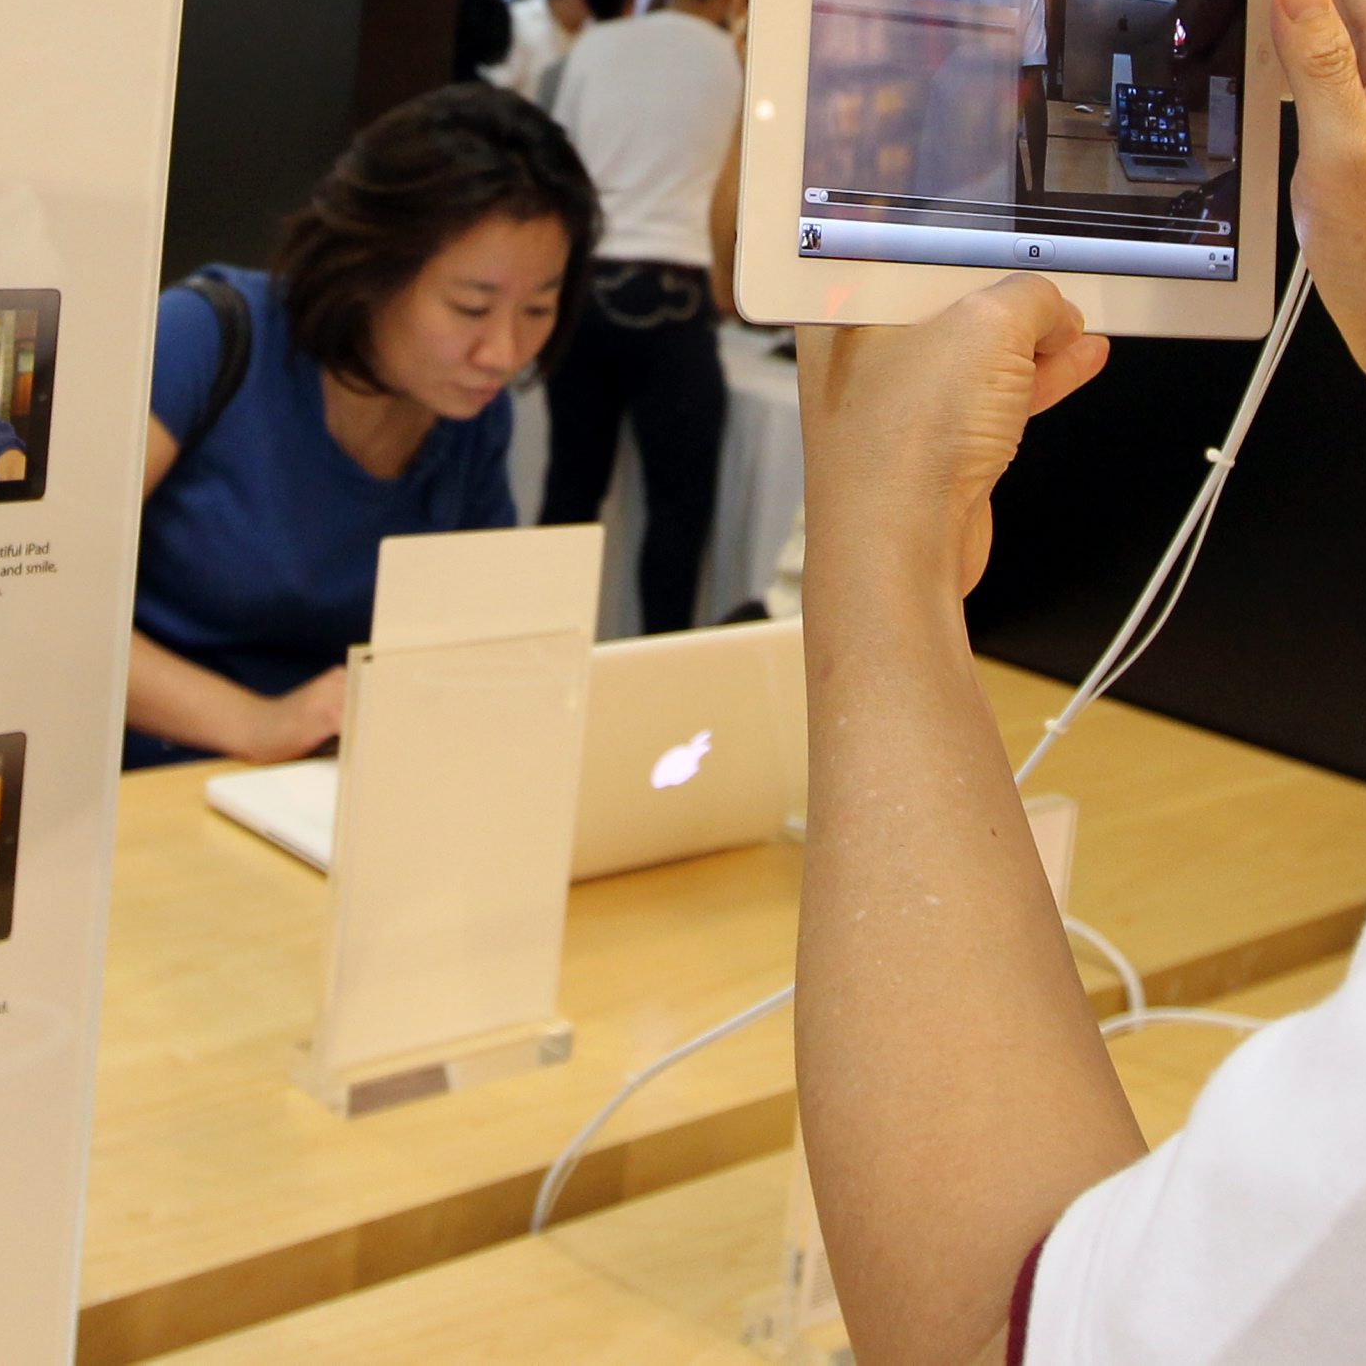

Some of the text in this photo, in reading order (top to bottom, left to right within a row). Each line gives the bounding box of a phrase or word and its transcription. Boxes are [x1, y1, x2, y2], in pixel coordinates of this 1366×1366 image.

[24, 542, 50, 556] iPad
[0, 562, 23, 578] and
[25, 560, 57, 575] smile,
